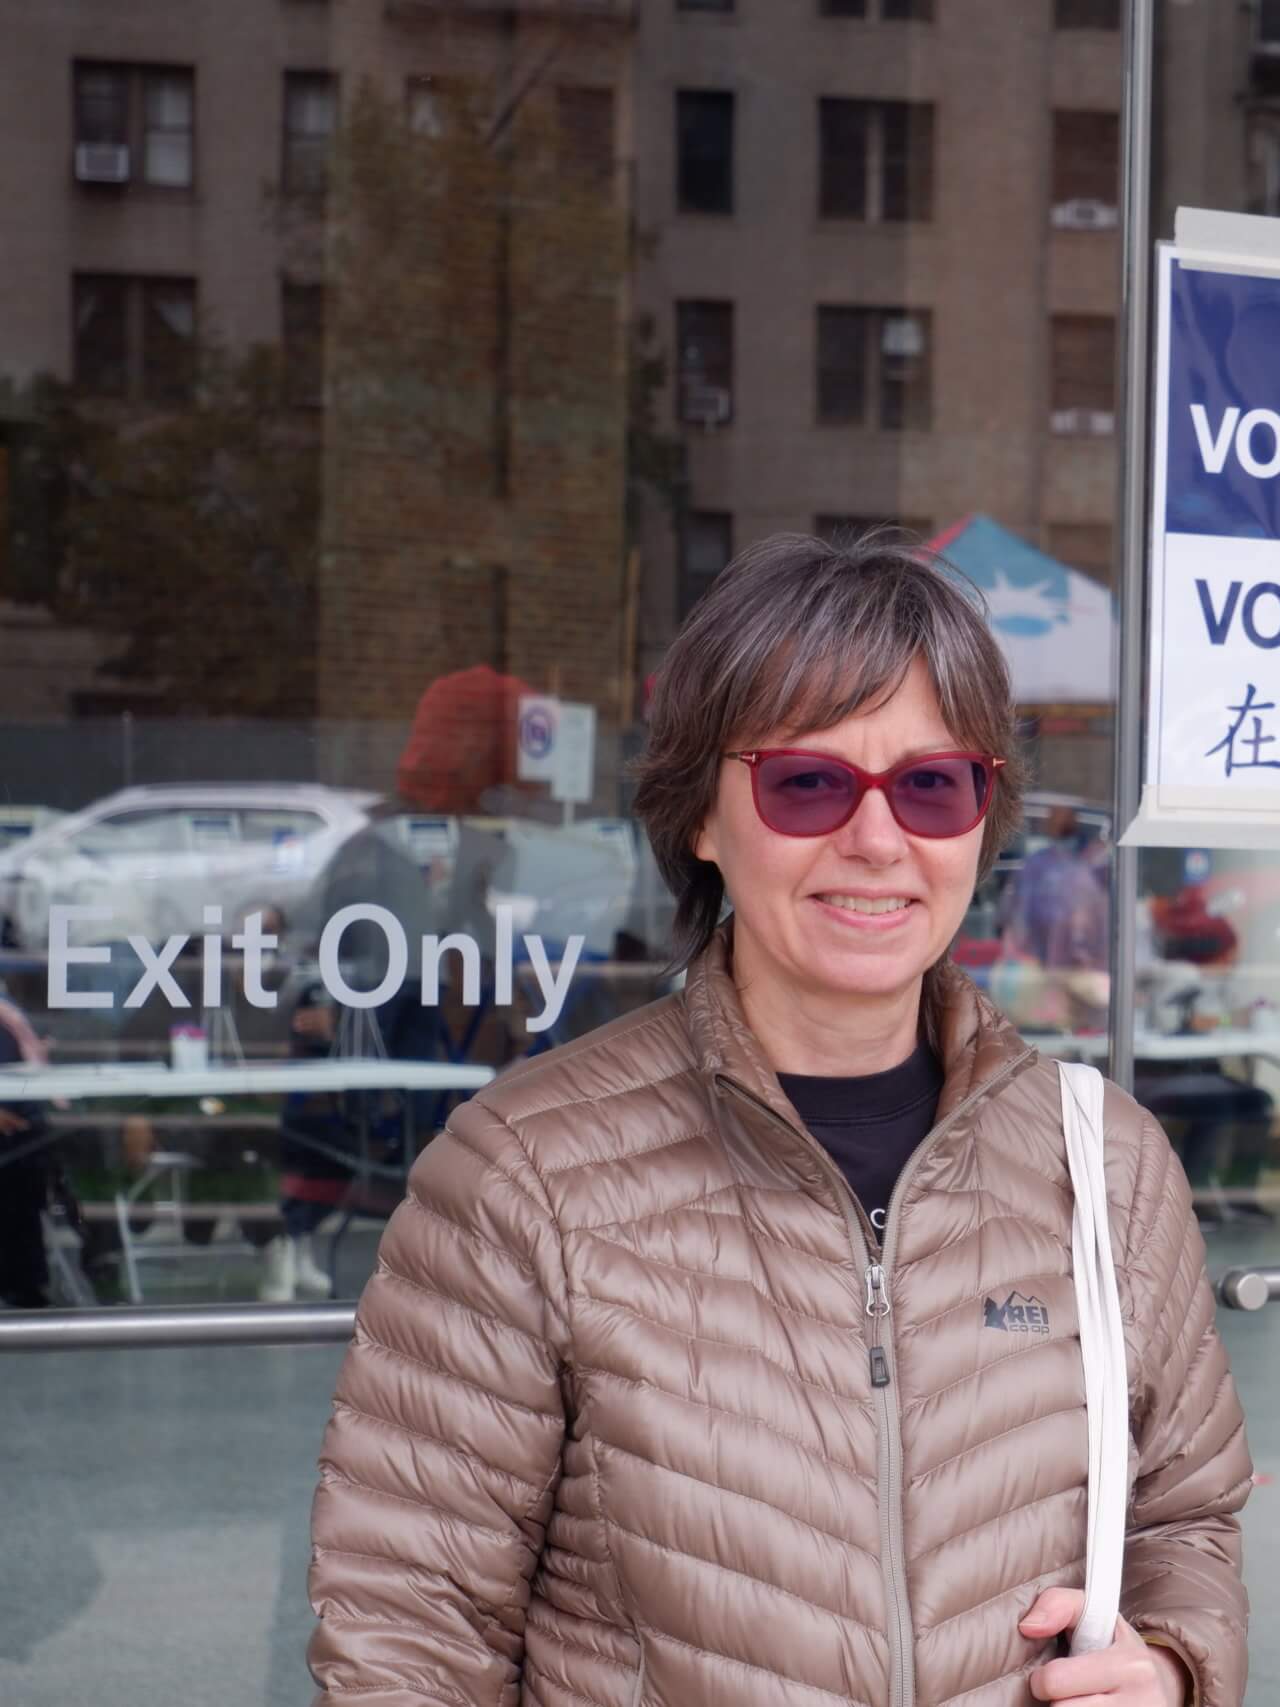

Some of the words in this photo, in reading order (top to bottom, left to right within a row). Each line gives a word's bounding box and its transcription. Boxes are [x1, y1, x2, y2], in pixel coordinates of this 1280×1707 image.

[47, 903, 278, 1009] Exit
[318, 903, 586, 1033] Only
[1007, 1305, 1049, 1325] REI
